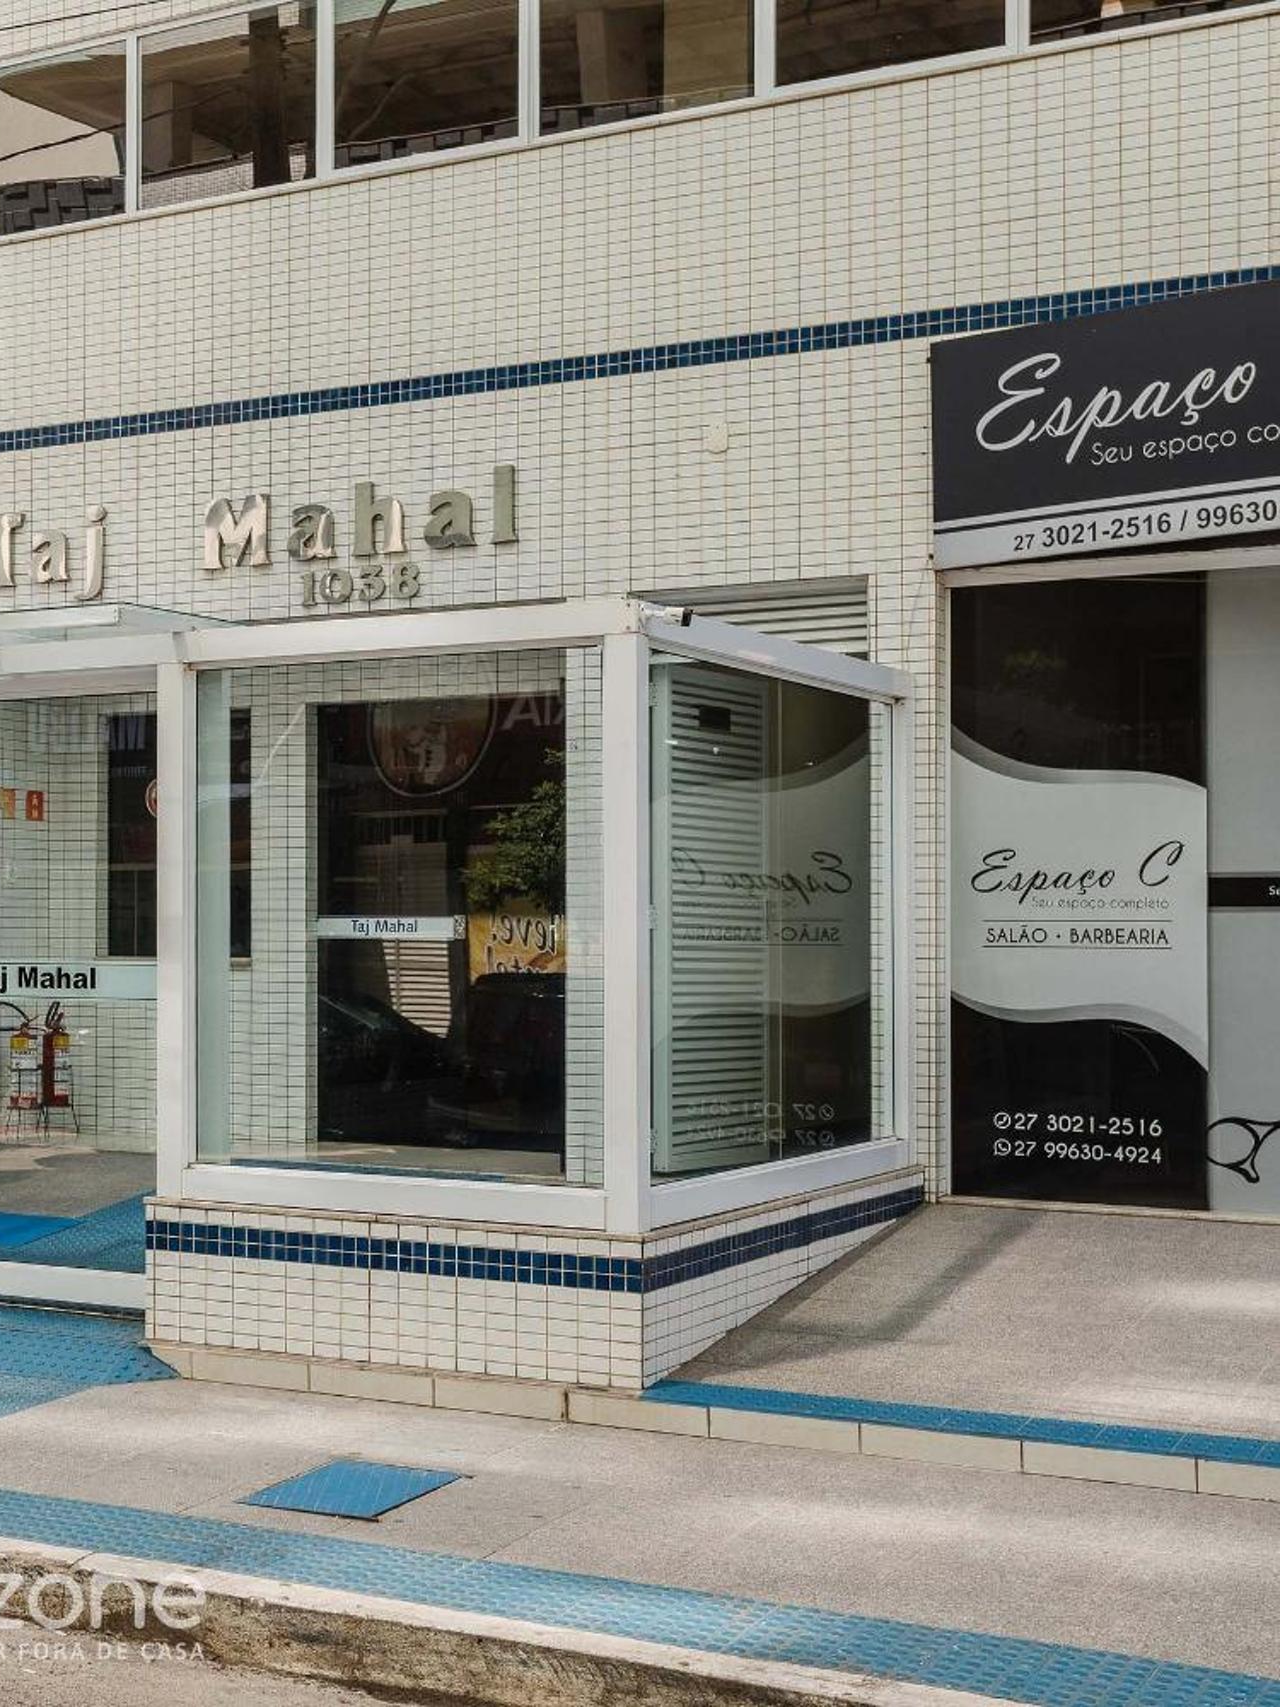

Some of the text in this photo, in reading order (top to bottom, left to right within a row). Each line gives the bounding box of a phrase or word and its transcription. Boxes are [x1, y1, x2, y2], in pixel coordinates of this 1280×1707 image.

[976, 353, 1256, 464] Espaço
[1091, 442, 1133, 465] Seu
[1143, 430, 1237, 459] espaço
[204, 464, 518, 570] Mahal
[1013, 533, 1035, 552] 27
[1042, 512, 1171, 547] 3021-2516
[301, 563, 421, 607] 1038
[970, 840, 1184, 905] Espaço C
[1031, 896, 1170, 911] Seu espaço completo
[351, 919, 418, 936] Taj Mahal
[986, 924, 1169, 944] SALÃO BARBEARIA
[18, 966, 97, 989] Mahal
[1014, 1113, 1162, 1137] 27 3021-2516
[1014, 1141, 1162, 1164] 27 99630-4924
